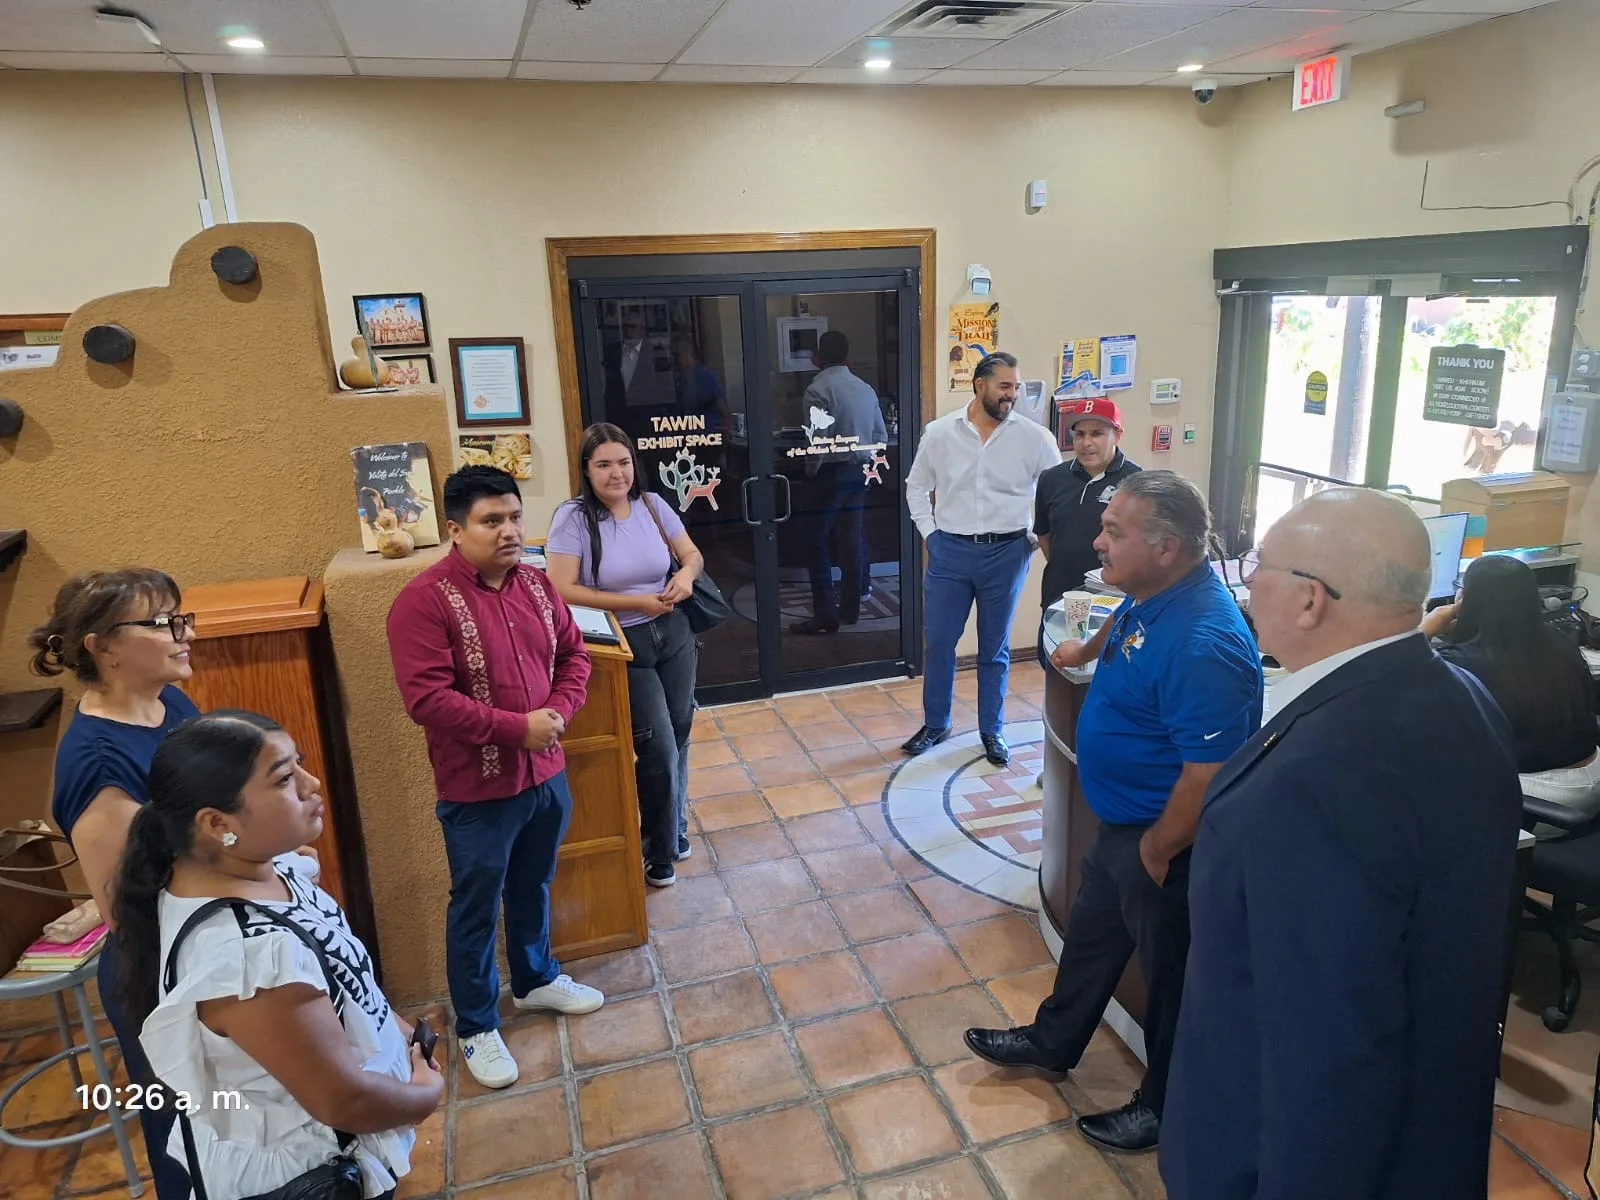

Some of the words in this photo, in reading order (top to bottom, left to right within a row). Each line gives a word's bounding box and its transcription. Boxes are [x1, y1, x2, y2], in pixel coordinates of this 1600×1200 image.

[1300, 57, 1337, 105] EXIT
[957, 319, 994, 329] MISSION
[1437, 356, 1471, 368] THANK
[1473, 358, 1495, 369] YOU
[1083, 401, 1095, 413] B
[650, 415, 706, 432] TAWIN
[637, 436, 685, 450] EXHIBIT
[685, 433, 722, 447] SPACE
